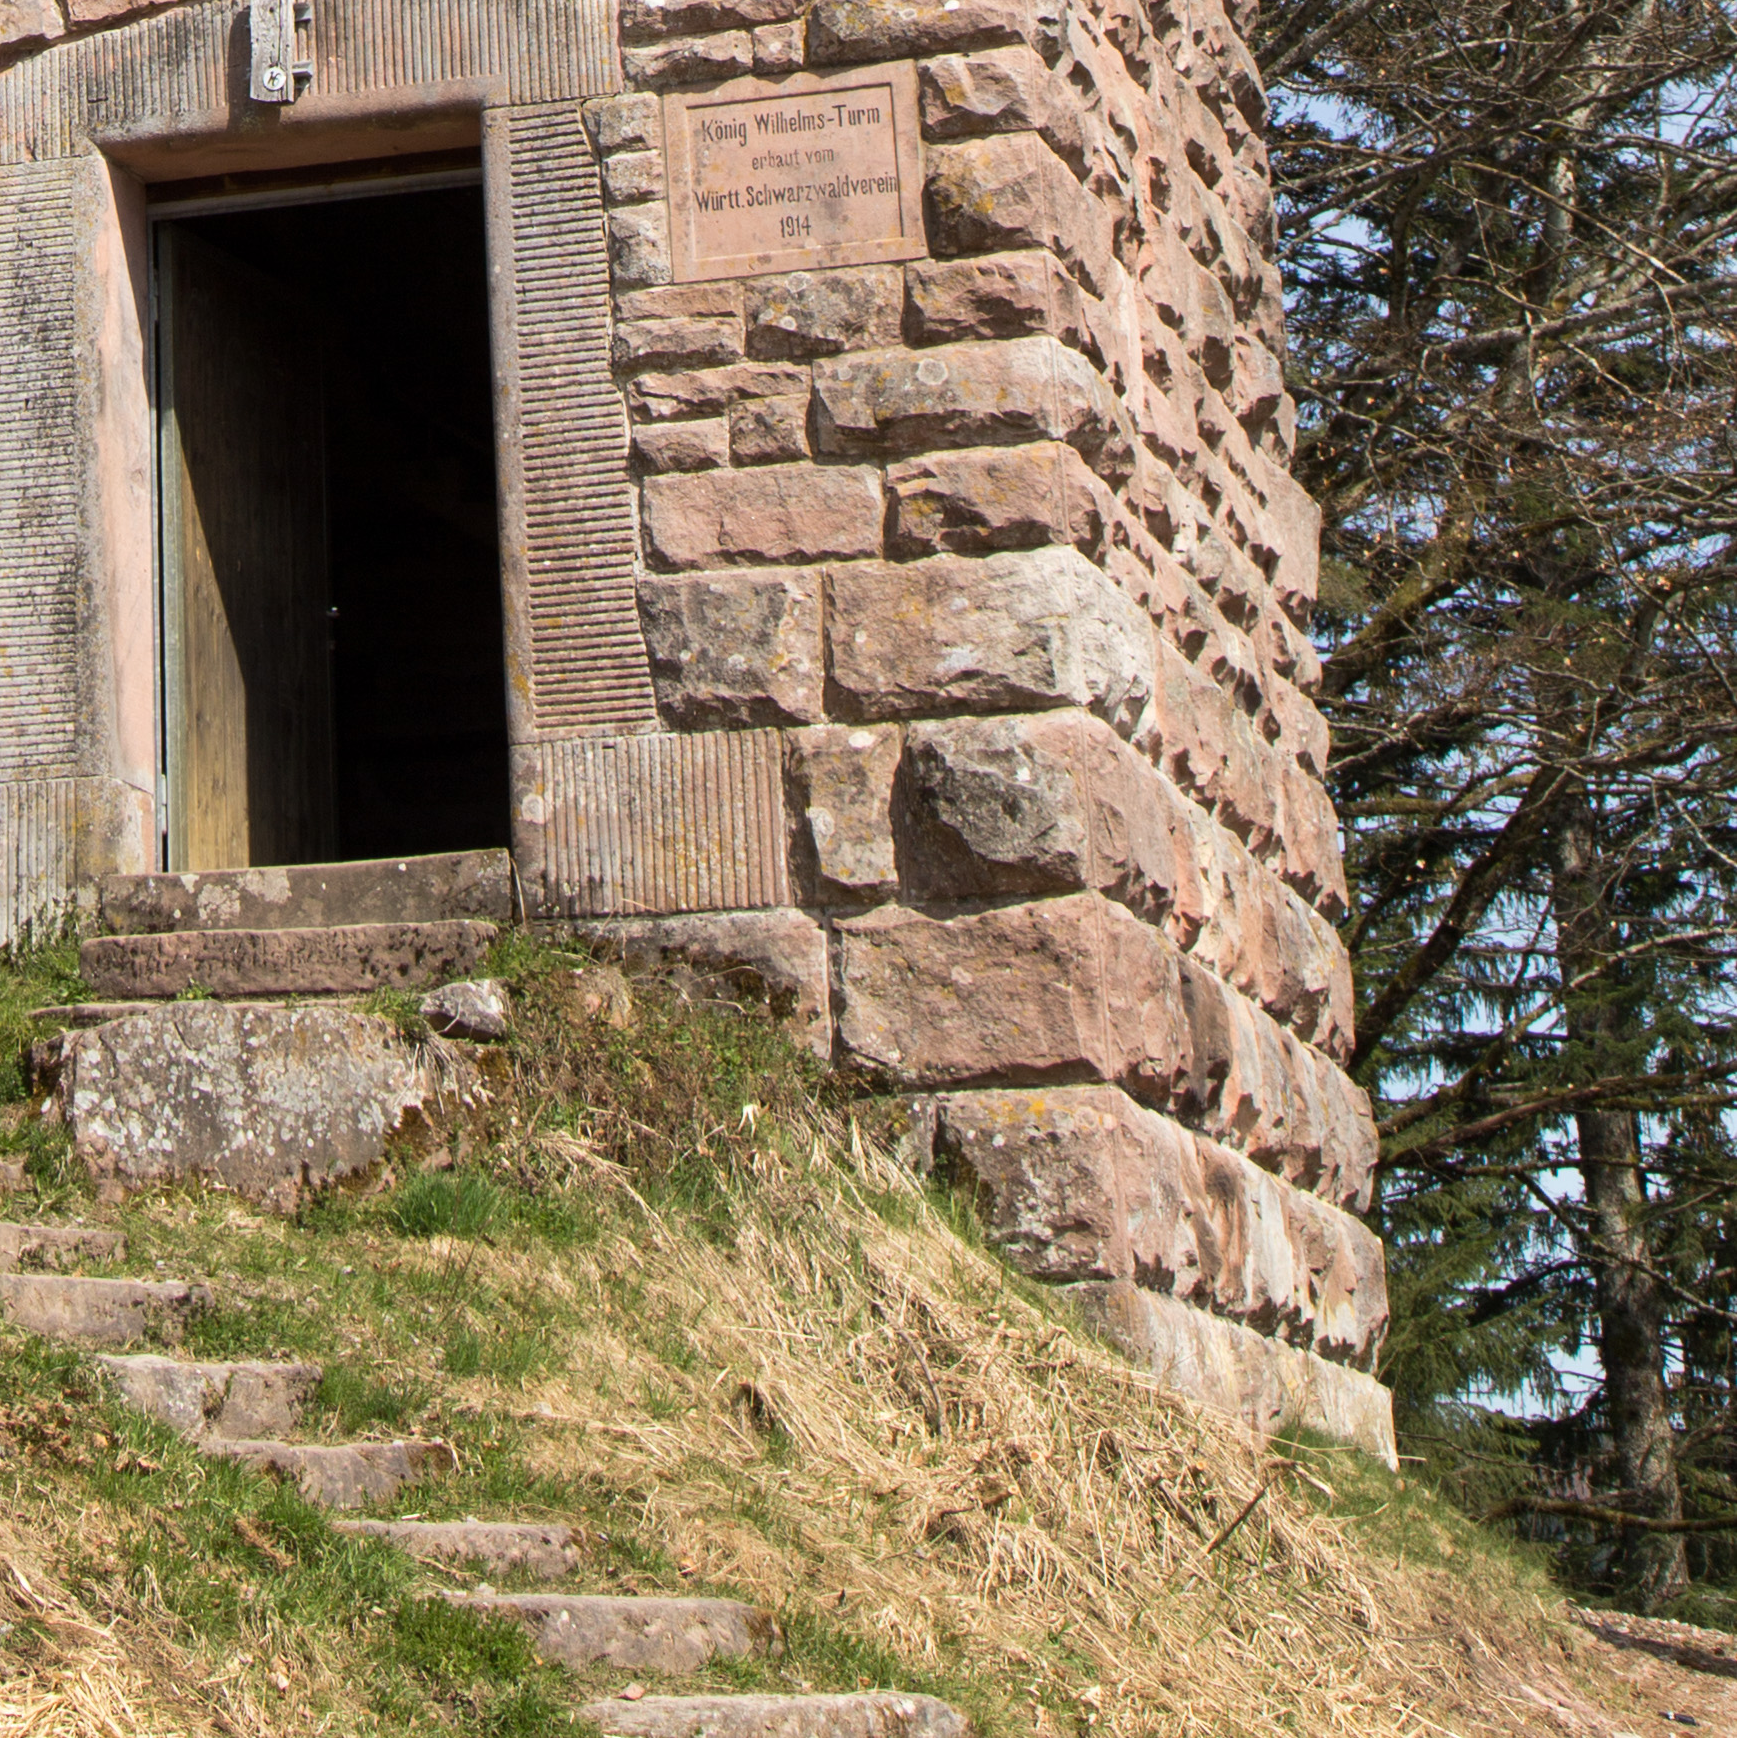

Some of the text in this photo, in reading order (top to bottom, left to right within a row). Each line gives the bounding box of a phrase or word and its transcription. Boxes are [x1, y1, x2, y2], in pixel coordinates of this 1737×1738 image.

[701, 105, 880, 147] König Wilhelms-Turm
[752, 148, 834, 170] erbaut vom
[780, 215, 812, 238] 1914
